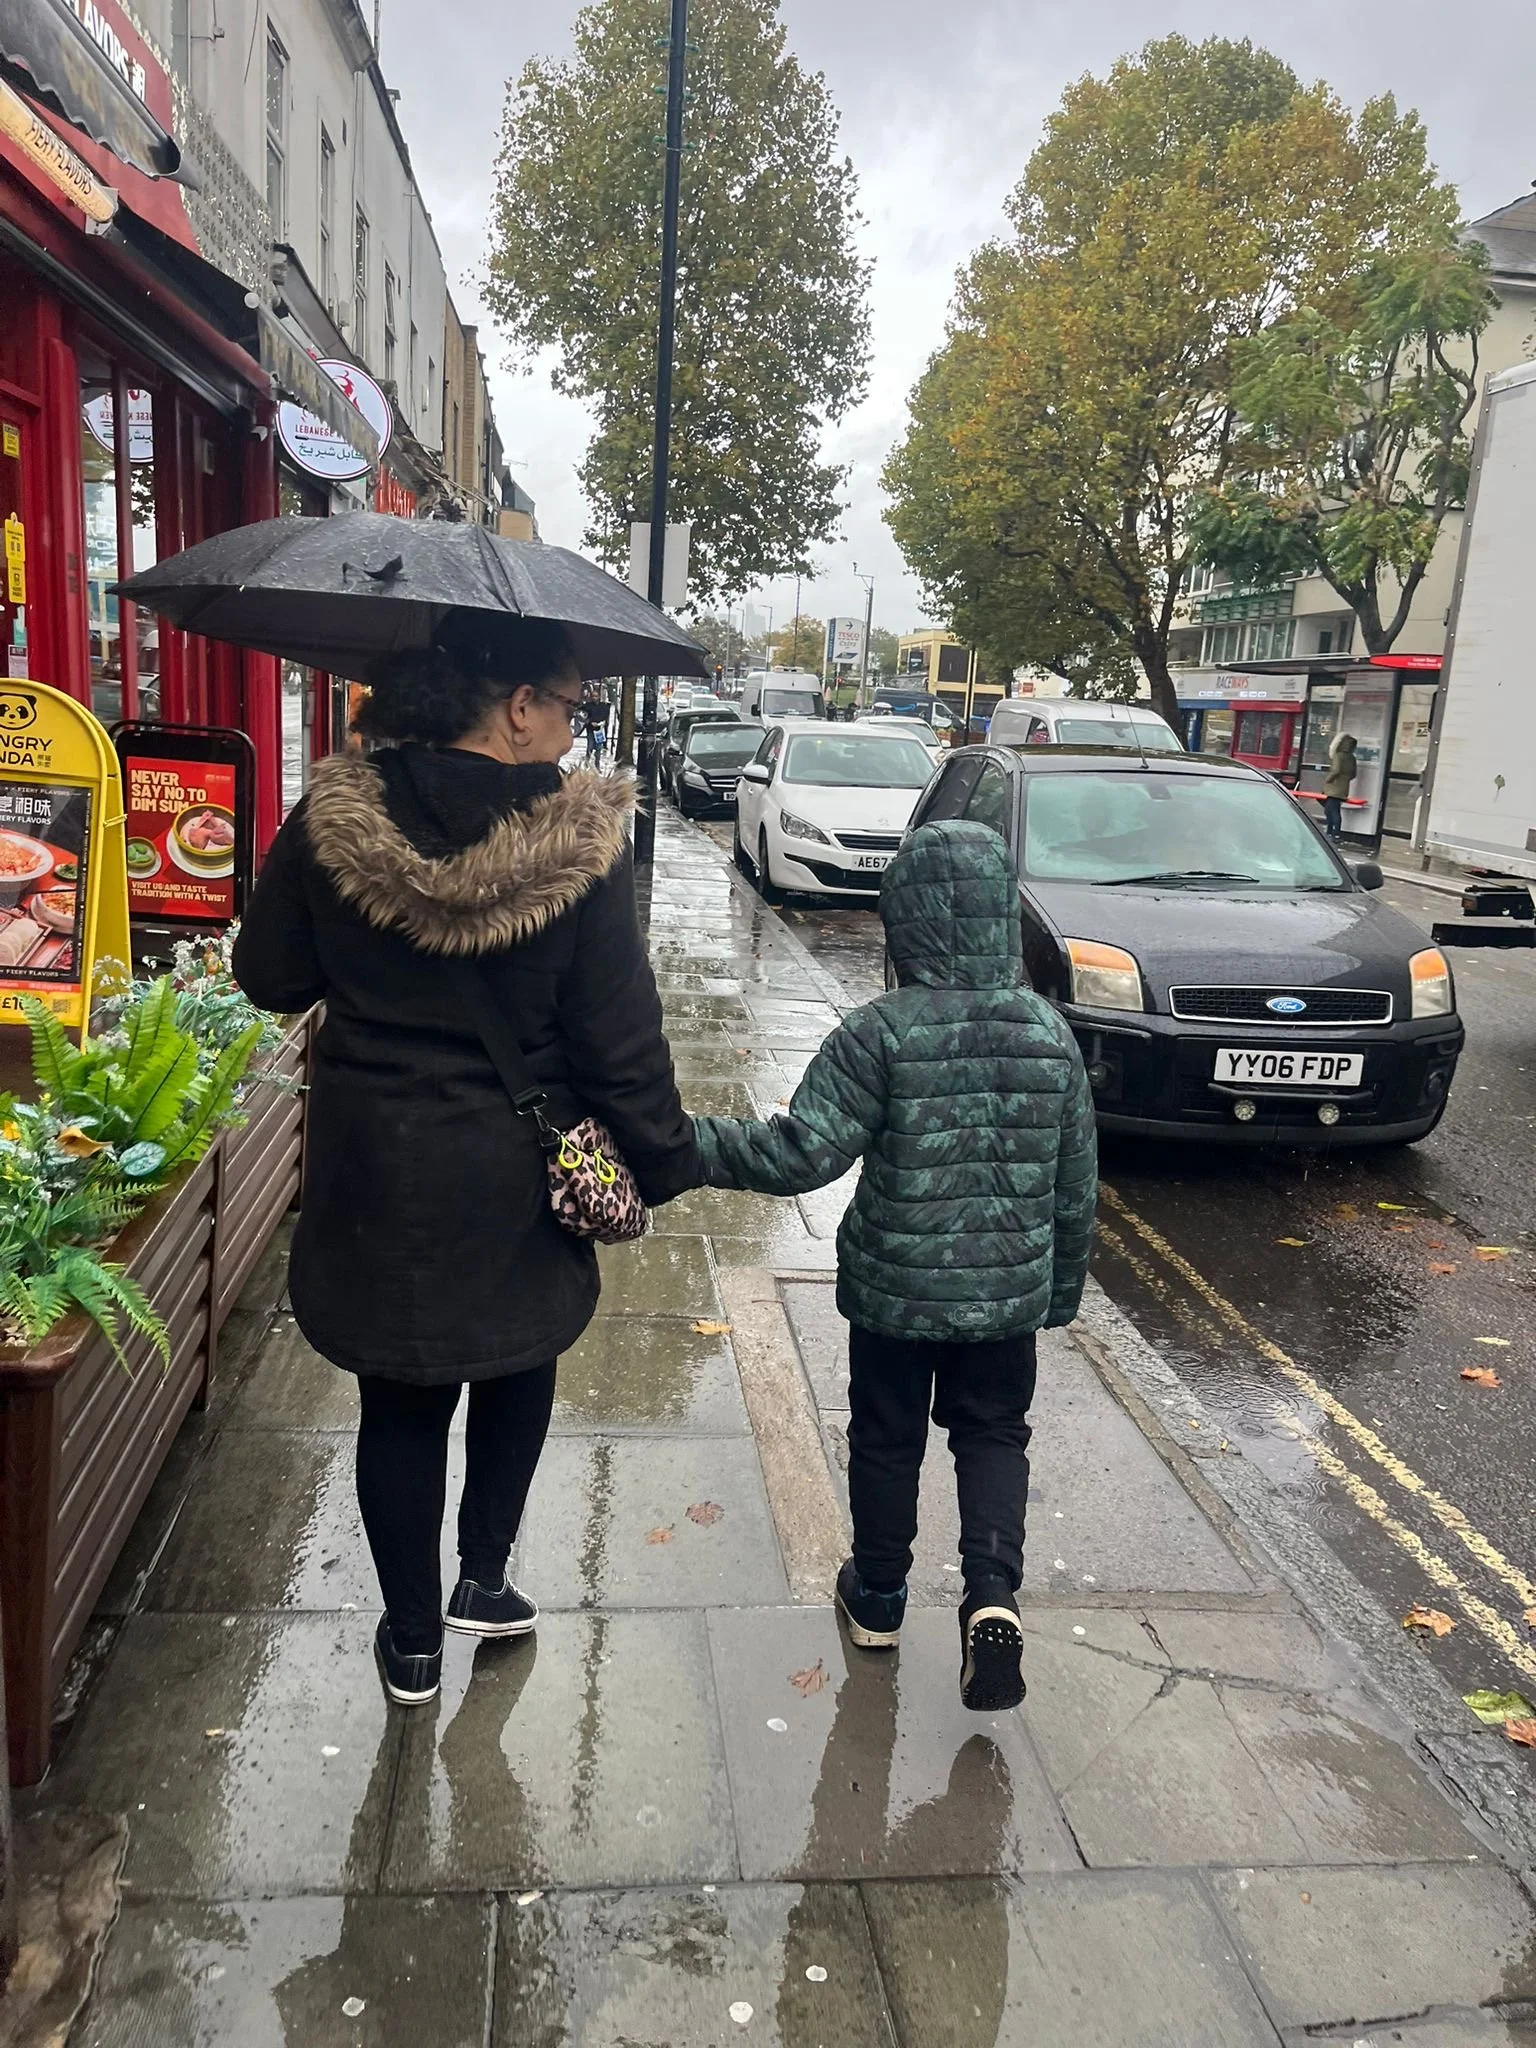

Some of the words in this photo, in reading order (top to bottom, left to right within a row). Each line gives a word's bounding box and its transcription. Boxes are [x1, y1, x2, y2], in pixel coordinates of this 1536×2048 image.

[25, 120, 55, 157] FIERY
[53, 145, 92, 195] FLAVORS
[131, 769, 179, 787] NEVER
[131, 783, 161, 799] SAY
[164, 786, 185, 801] NO
[187, 788, 207, 803] TO
[131, 797, 157, 812] DIM
[159, 799, 190, 814] SUM
[18, 815, 52, 826] FLAVORS
[857, 856, 888, 869] AE67
[131, 880, 152, 890] VISIT
[152, 882, 163, 891] US
[164, 883, 181, 892] AND
[181, 884, 208, 894] TASTE
[131, 888, 173, 899] TRADITION
[173, 891, 194, 900] WITH
[194, 892, 201, 901] A
[201, 893, 228, 903] TWIST
[1277, 1001, 1298, 1011] Ford
[1228, 1053, 1295, 1079] YY06
[1300, 1055, 1353, 1081] FDP
